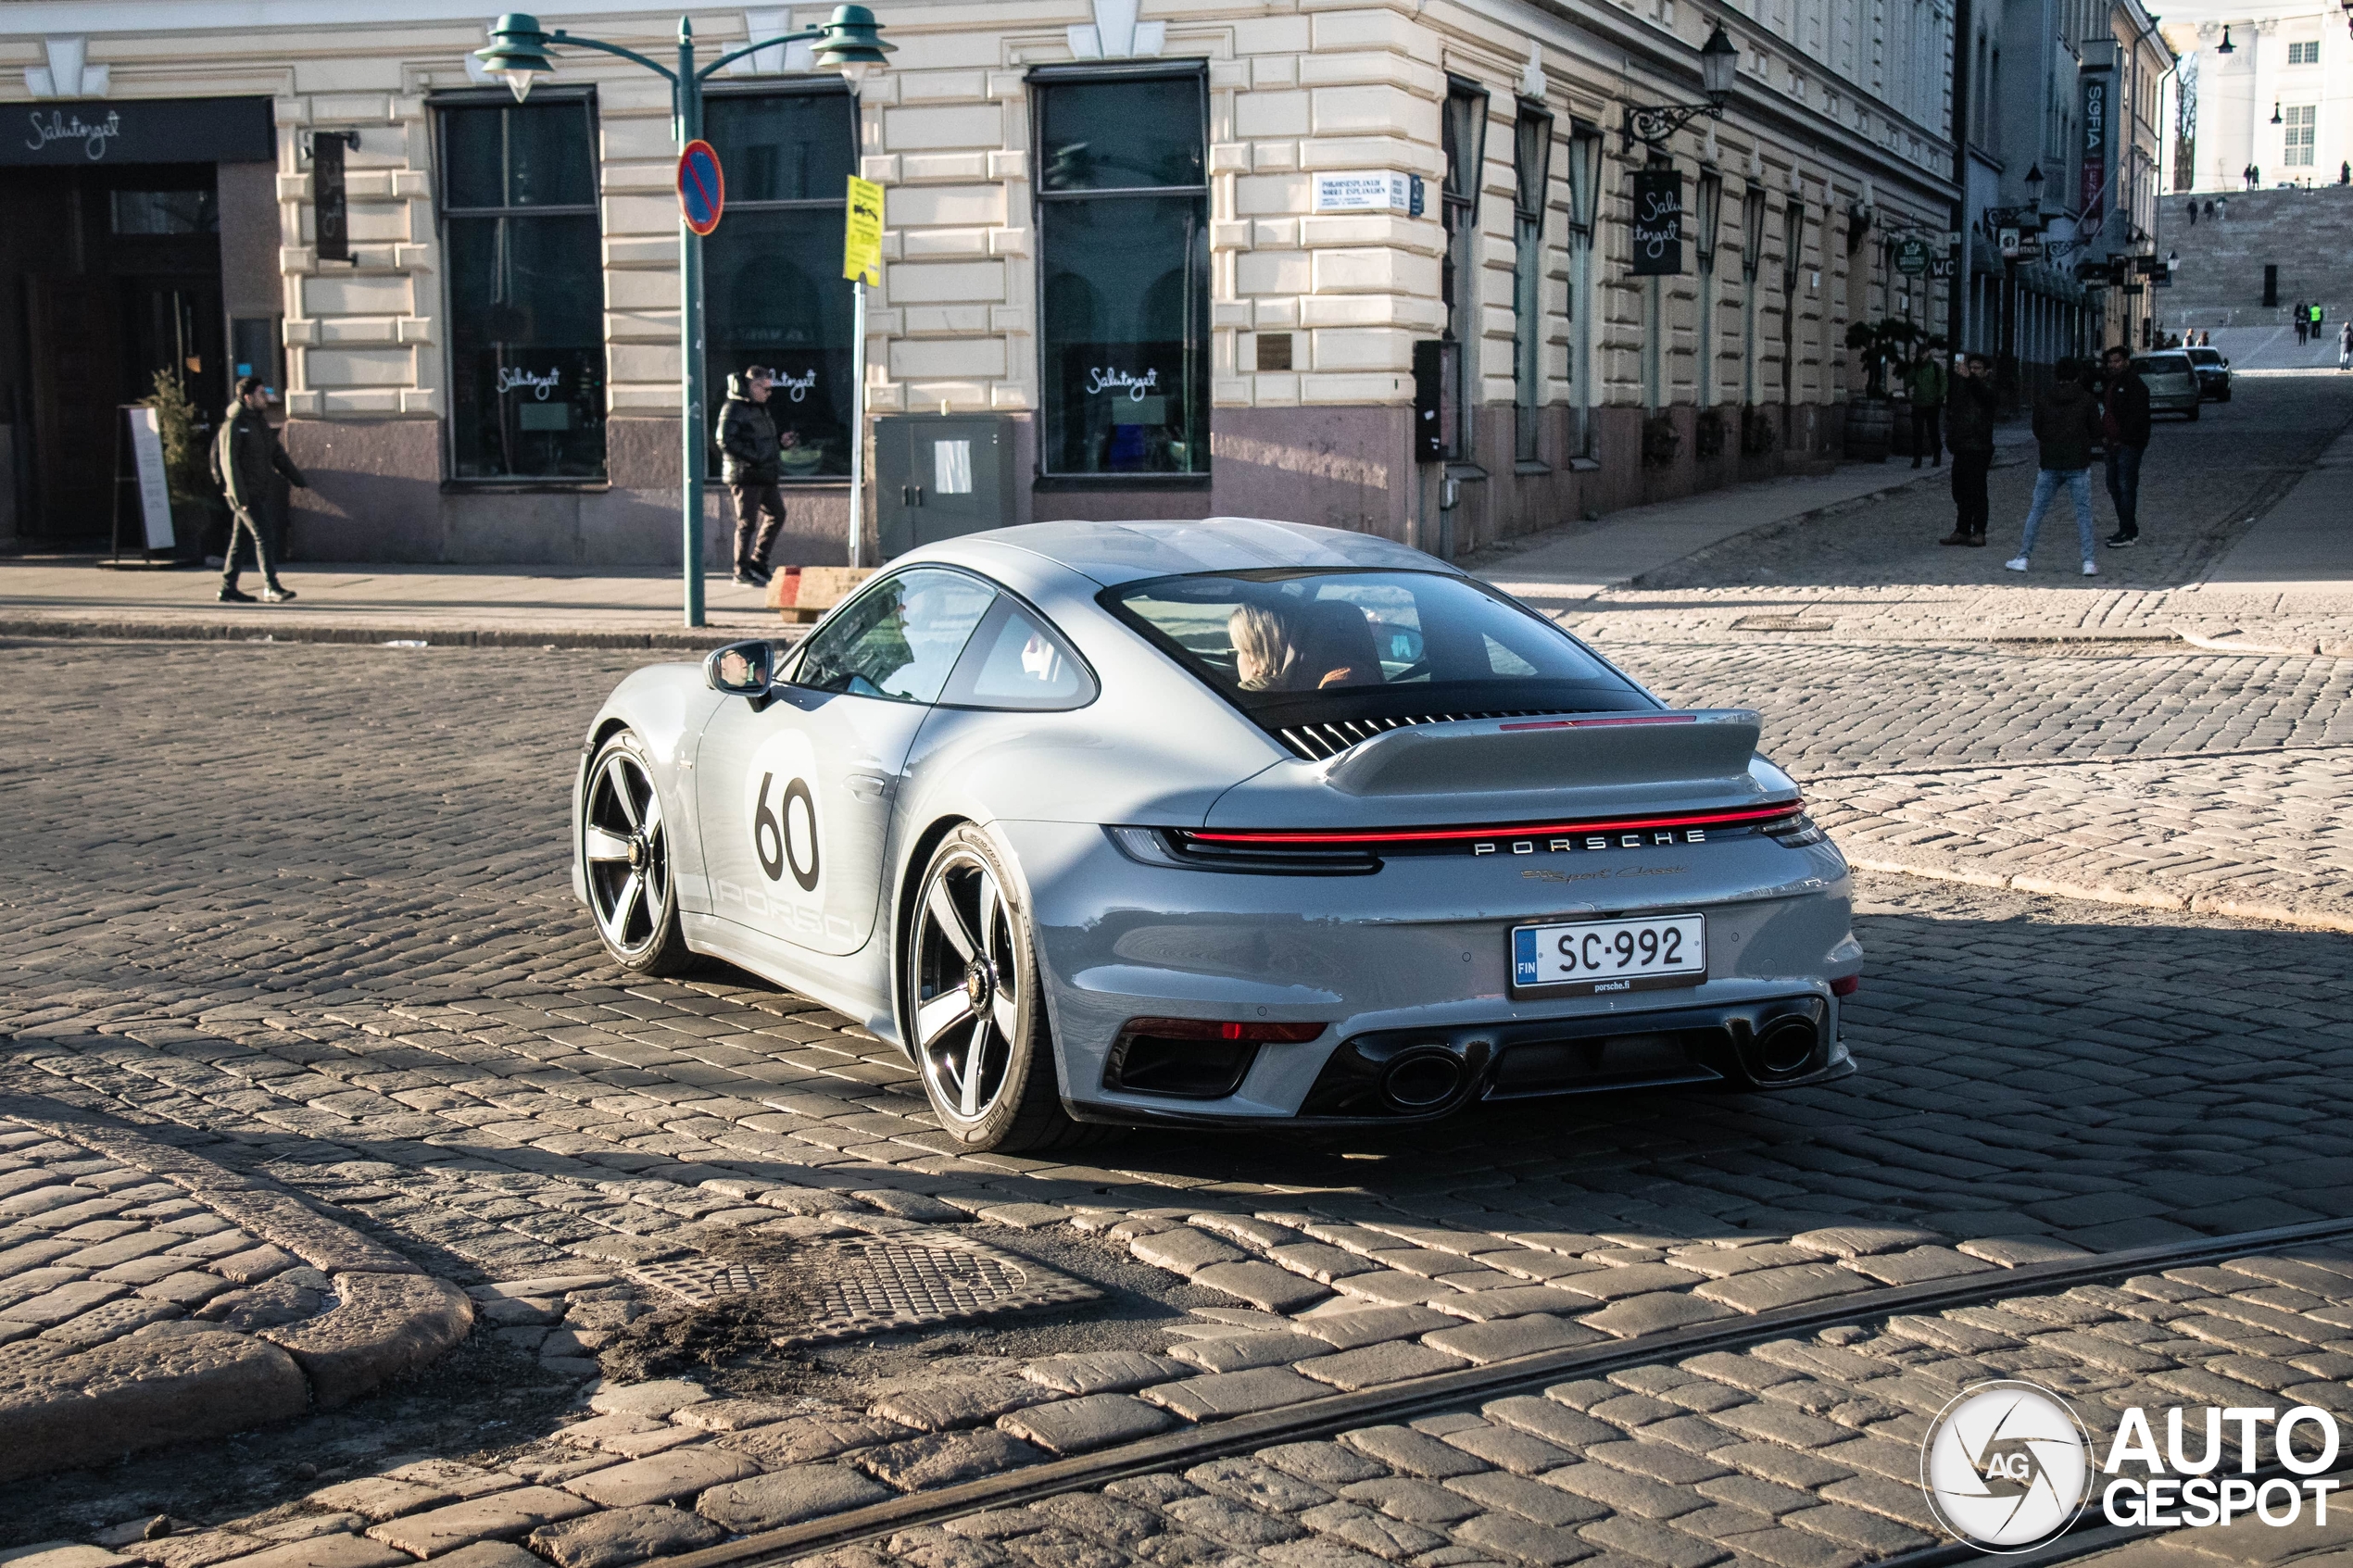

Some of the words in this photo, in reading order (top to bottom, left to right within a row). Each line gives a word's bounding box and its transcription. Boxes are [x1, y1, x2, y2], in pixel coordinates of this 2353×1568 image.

[2087, 85, 2102, 149] SOFIA
[25, 110, 120, 160] Salutorget
[1641, 191, 1682, 221] Salu
[1932, 260, 1955, 276] WC
[496, 367, 560, 401] Salutorget
[1086, 367, 1158, 402] Salutorget
[755, 771, 820, 892] 60
[1475, 830, 1705, 856] PORSCHE
[1616, 864, 1690, 878] Classic
[1557, 926, 1683, 972] SC-992
[1517, 961, 1536, 974] FIN
[1594, 980, 1630, 993] porsche.fi
